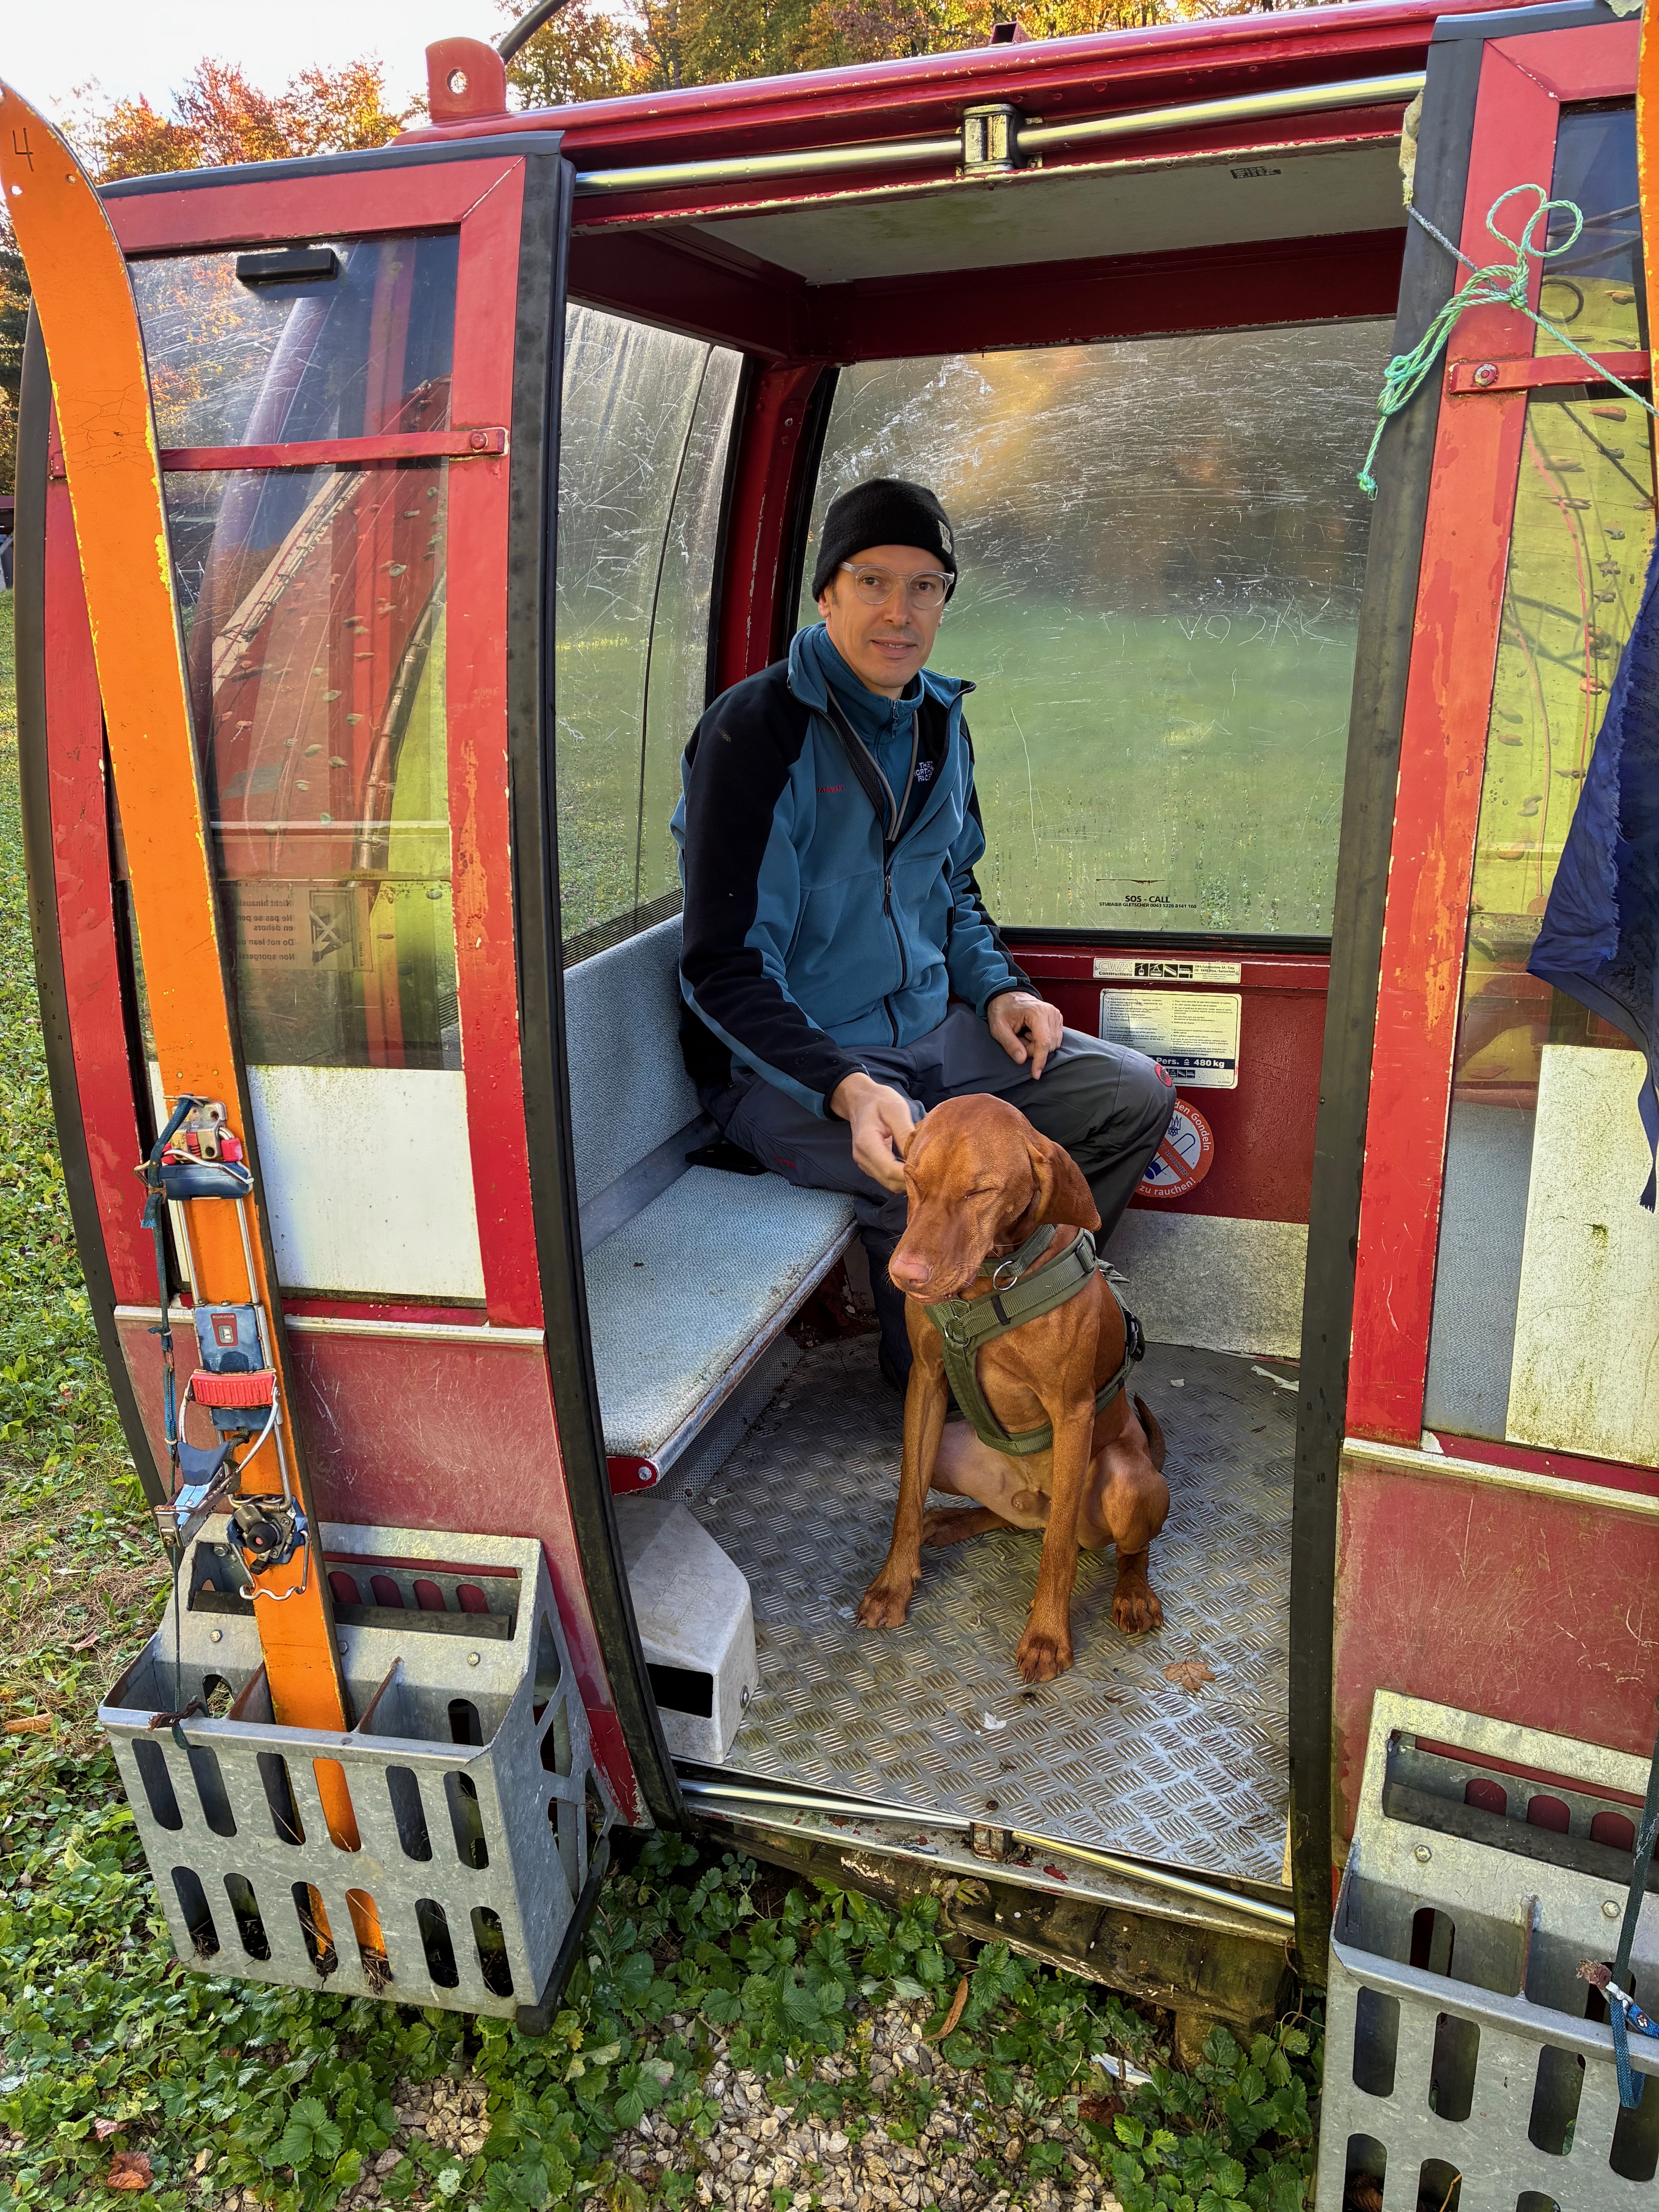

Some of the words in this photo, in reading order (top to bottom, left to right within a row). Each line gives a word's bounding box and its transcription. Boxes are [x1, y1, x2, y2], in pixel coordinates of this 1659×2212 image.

[12, 127, 34, 172] 4
[1099, 961, 1132, 972] CWA
[1156, 1057, 1180, 1065] Pers.
[1213, 1060, 1225, 1068] kg
[1191, 1113, 1212, 1151] Gondeln
[1139, 1185, 1151, 1194] zu
[1154, 1176, 1196, 1195] rauchen!
